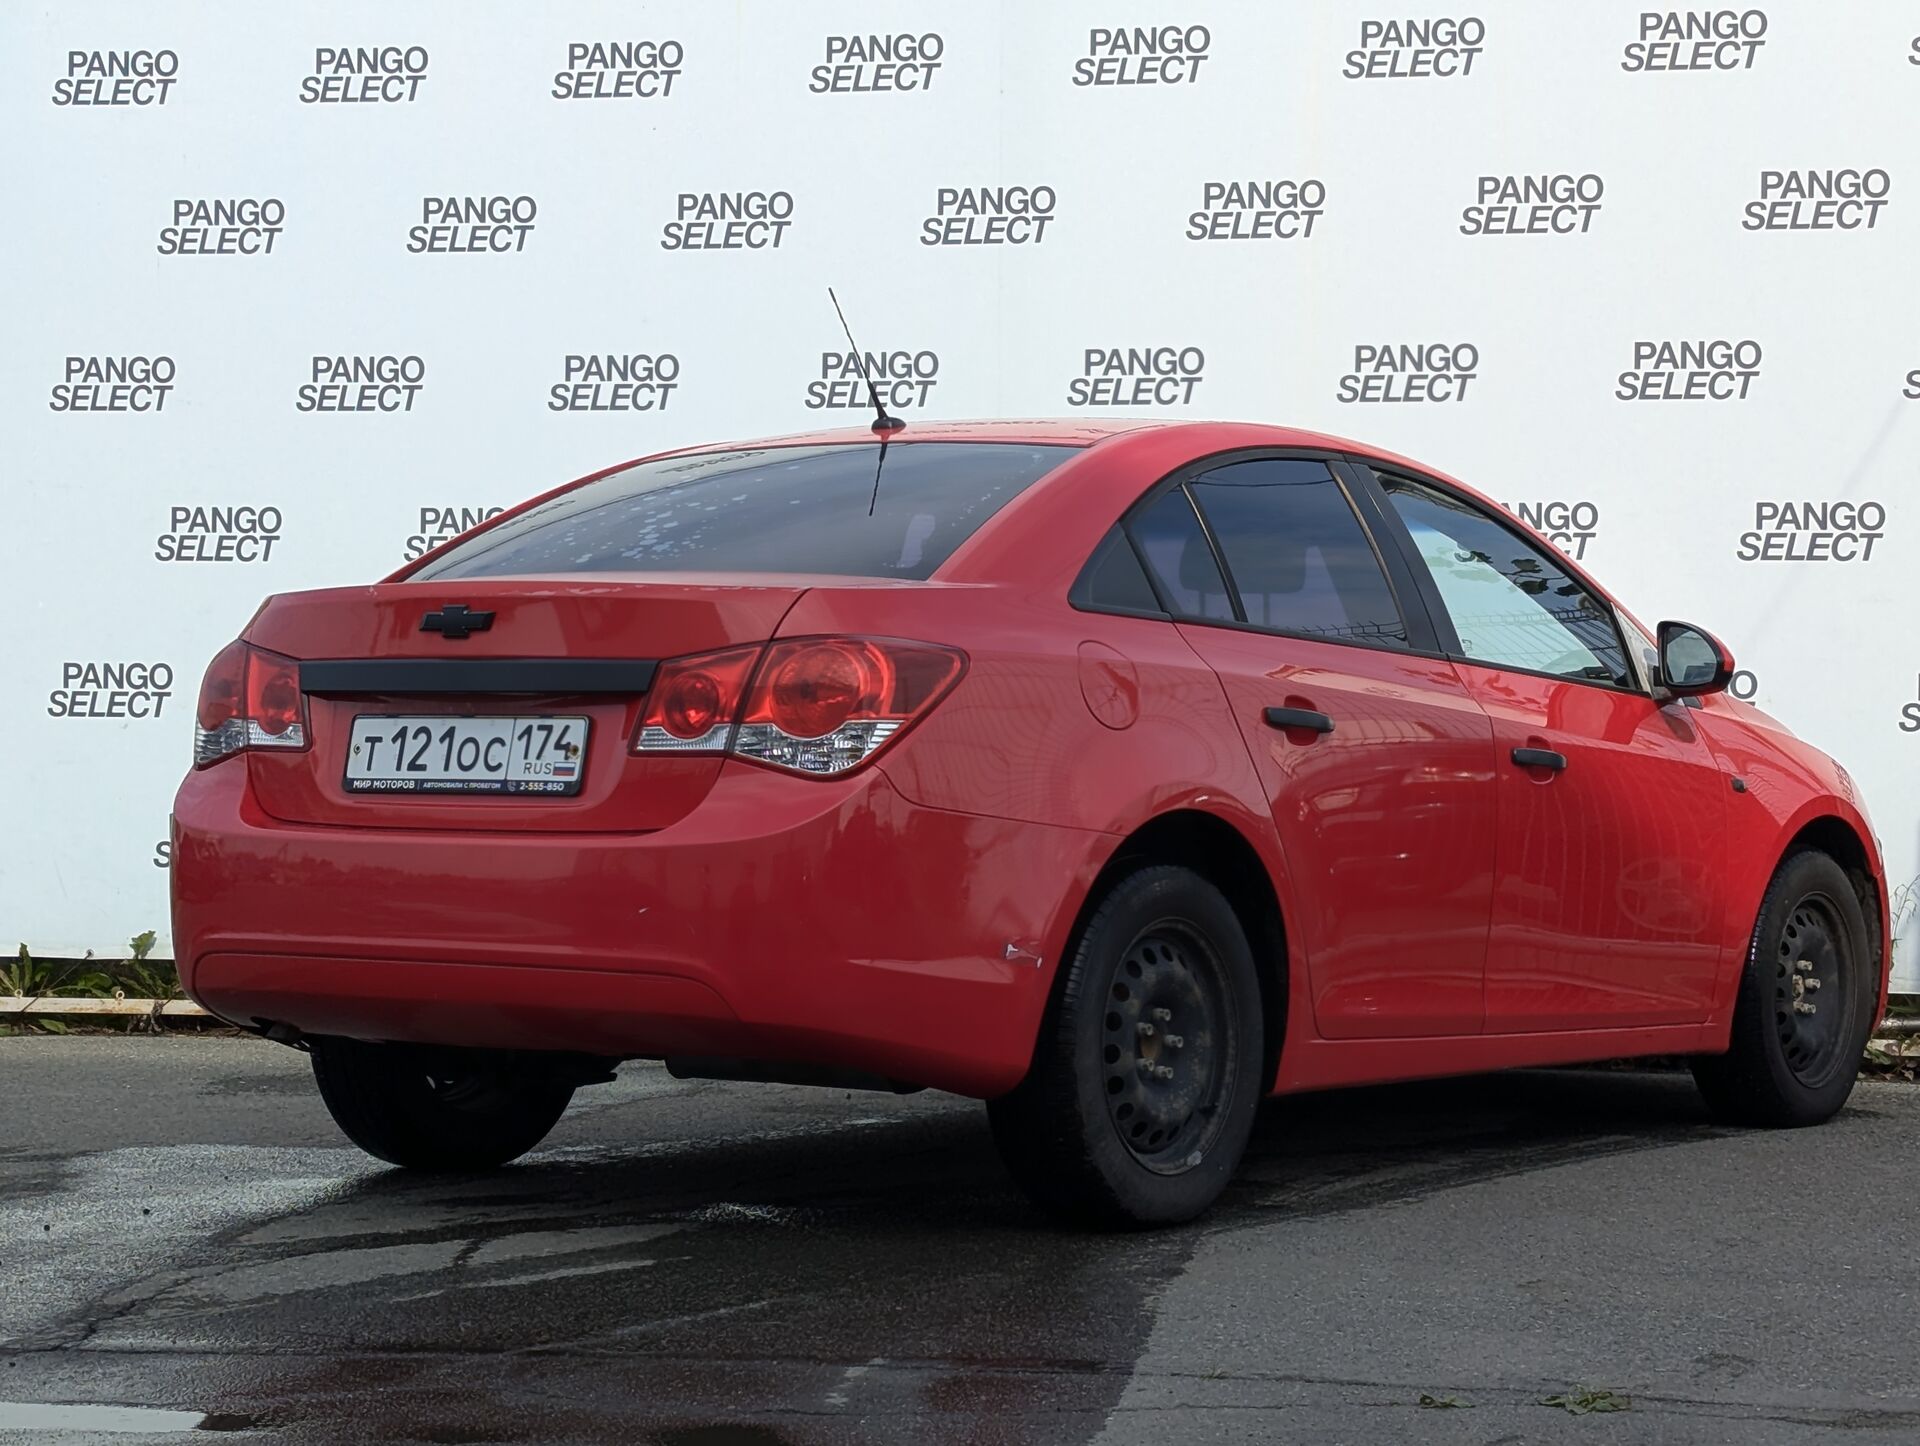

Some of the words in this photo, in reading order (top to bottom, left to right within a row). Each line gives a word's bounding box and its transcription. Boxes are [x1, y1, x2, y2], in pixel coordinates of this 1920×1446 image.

[1361, 18, 1485, 48] PANGO
[1640, 10, 1767, 40] PANGO
[827, 33, 943, 63] PANGO
[1090, 25, 1210, 56] PANGO
[69, 50, 178, 77] PANGO
[316, 46, 428, 74] PANGO
[569, 41, 683, 70] PANGO
[1343, 48, 1483, 79] SELECT
[1621, 41, 1765, 71] SELECT
[552, 70, 681, 99] SELECT
[809, 63, 941, 93] SELECT
[1072, 55, 1208, 86] SELECT
[52, 79, 177, 105] SELECT
[299, 75, 426, 103] SELECT
[1204, 180, 1325, 210] PANGO
[1478, 174, 1603, 204] PANGO
[1761, 169, 1890, 199] PANGO
[174, 199, 284, 226] PANGO
[424, 196, 536, 224] PANGO
[678, 192, 793, 220] PANGO
[938, 186, 1056, 215] PANGO
[1742, 200, 1888, 230] SELECT
[920, 216, 1054, 245] SELECT
[1186, 210, 1323, 240] SELECT
[1460, 205, 1601, 235] SELECT
[157, 227, 283, 254] SELECT
[407, 225, 535, 253] SELECT
[661, 221, 792, 250] SELECT
[565, 354, 679, 382] PANGO
[822, 351, 938, 379] PANGO
[1085, 347, 1204, 376] PANGO
[1355, 344, 1478, 372] PANGO
[1634, 340, 1762, 369] PANGO
[66, 357, 175, 383] PANGO
[313, 356, 424, 383] PANGO
[49, 385, 173, 411] SELECT
[296, 385, 423, 411] SELECT
[548, 383, 677, 411] SELECT
[805, 380, 937, 408] SELECT
[1067, 377, 1202, 406] SELECT
[1337, 374, 1476, 403] SELECT
[1615, 371, 1760, 400] SELECT
[171, 507, 282, 533] PANGO
[421, 507, 505, 534] PAN
[1501, 502, 1598, 530] NGO
[1756, 502, 1885, 531] PANGO
[155, 535, 280, 562] SELECT
[1737, 532, 1883, 561] SELECT
[63, 663, 173, 690] PANGO
[48, 690, 171, 718] SELECT
[517, 724, 573, 760] 174
[523, 762, 552, 775] RUS
[353, 780, 371, 788] МИР
[373, 780, 415, 789] МОТОРОВ
[519, 782, 565, 791] 2-555-850
